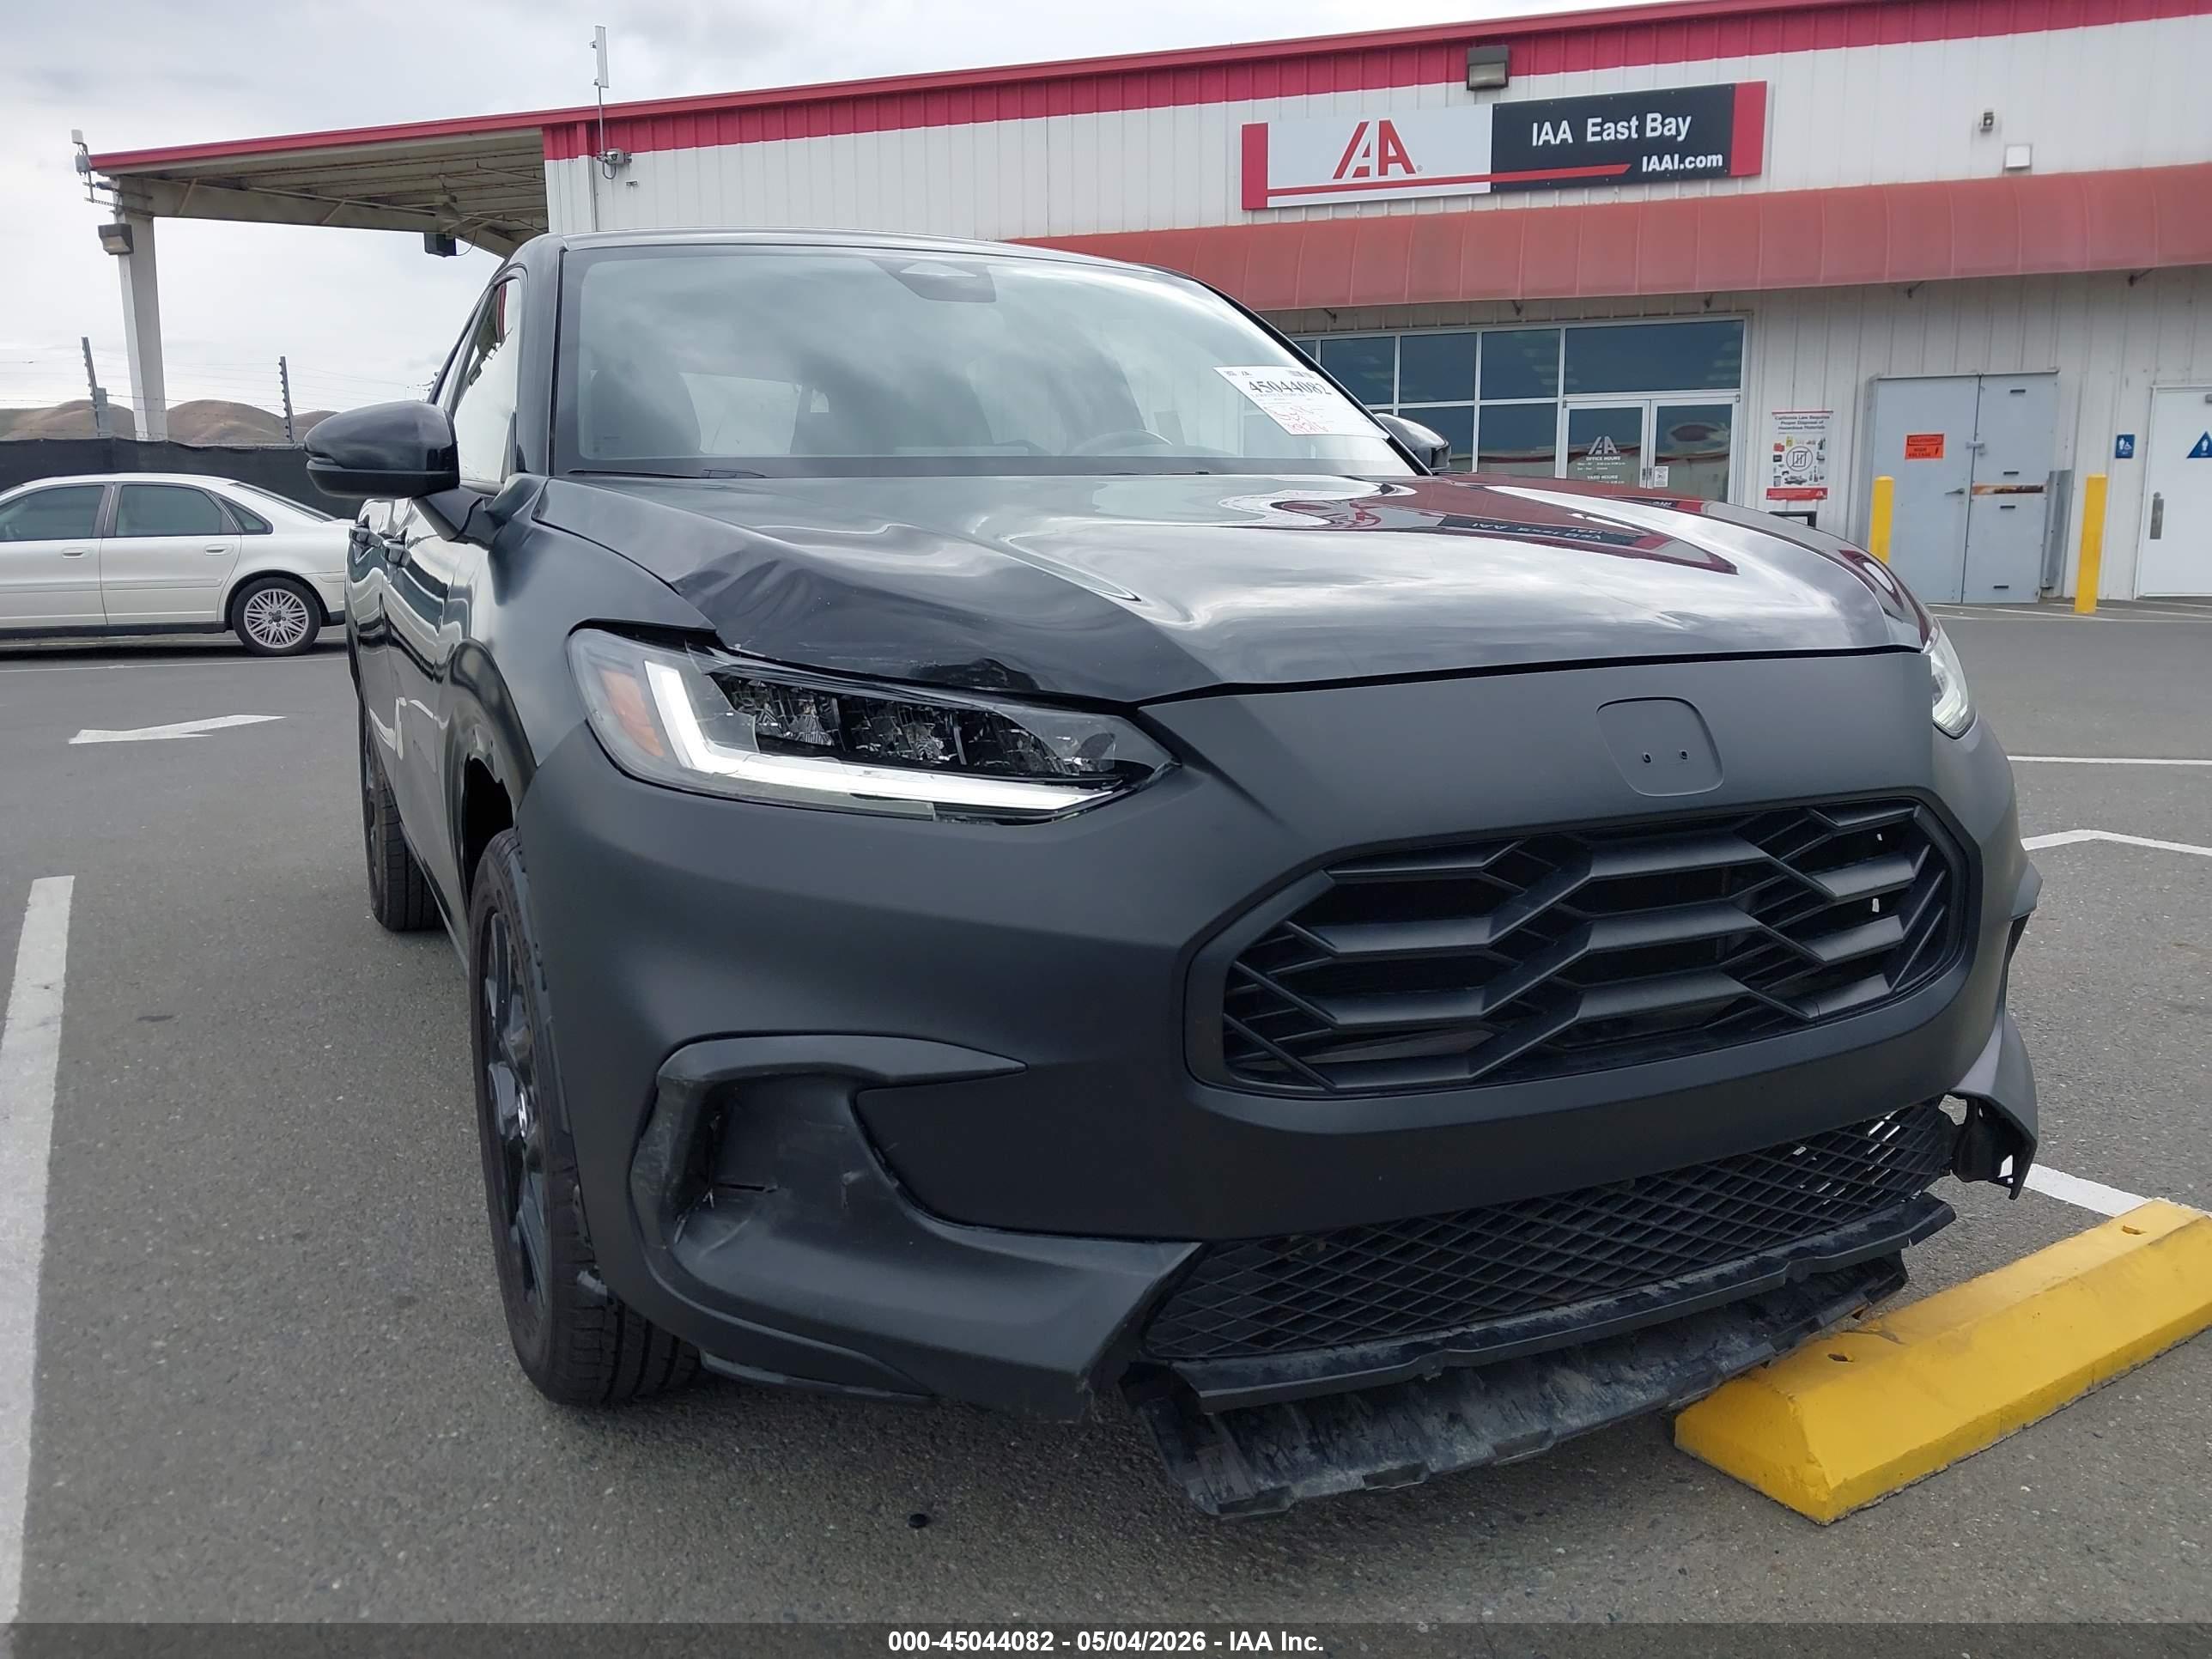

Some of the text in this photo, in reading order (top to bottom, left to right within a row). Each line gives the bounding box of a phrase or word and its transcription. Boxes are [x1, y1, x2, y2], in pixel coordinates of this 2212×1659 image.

[1532, 112, 1692, 147] IAA East Bay
[1642, 153, 1724, 173] IAAI.com
[1249, 380, 1332, 395] 45044082
